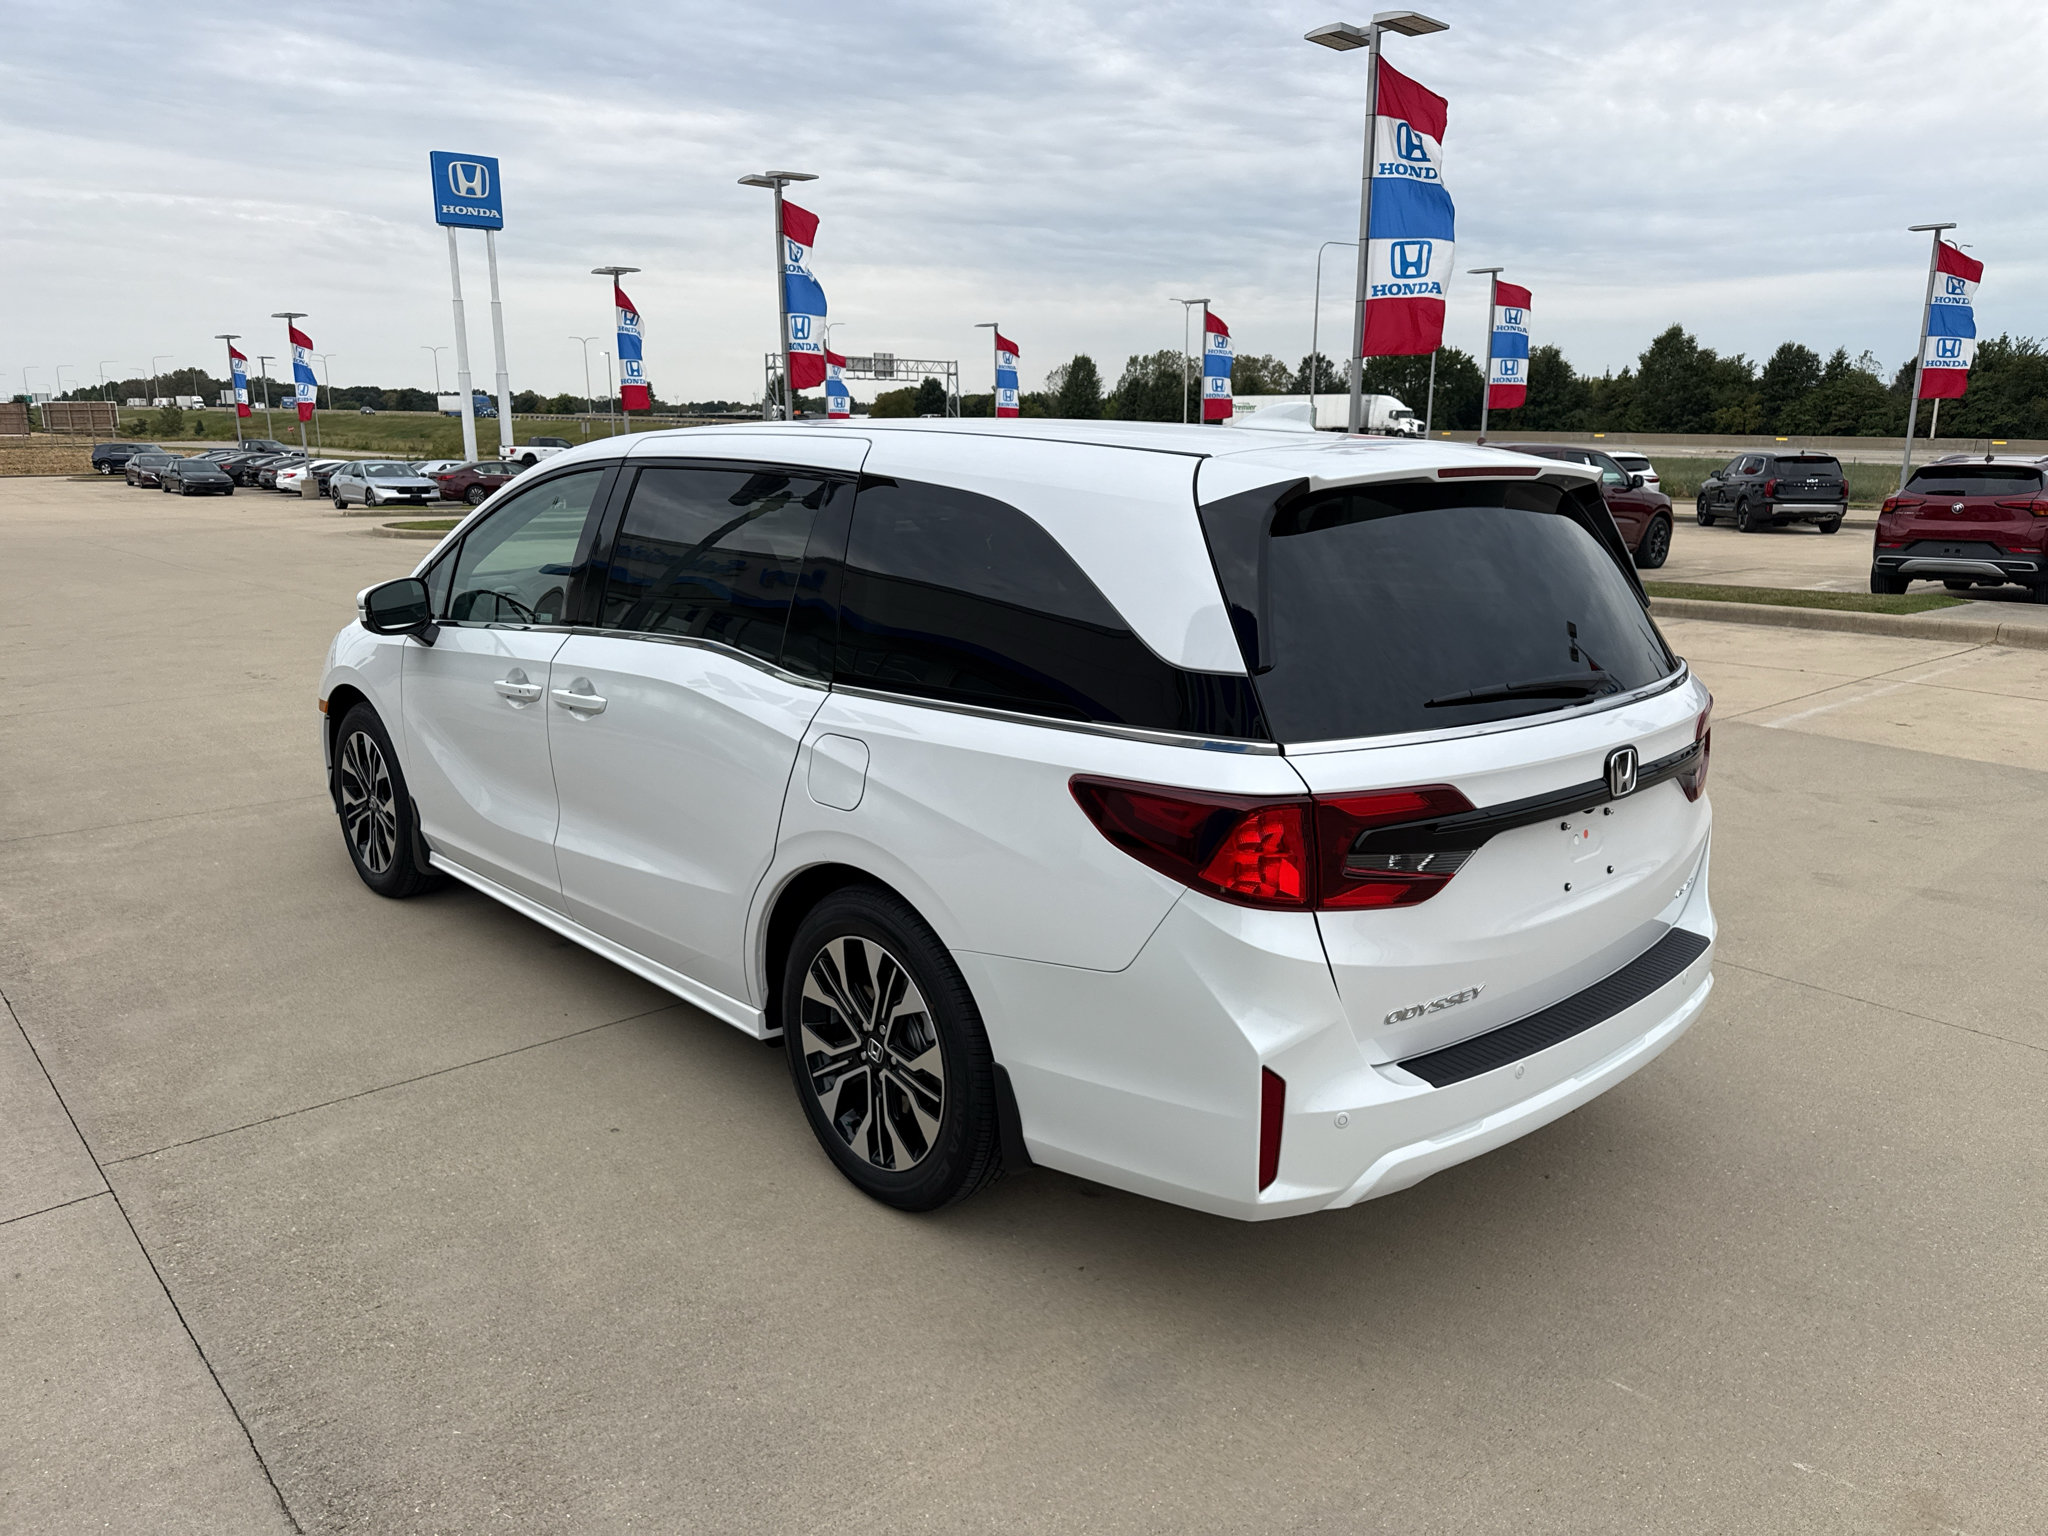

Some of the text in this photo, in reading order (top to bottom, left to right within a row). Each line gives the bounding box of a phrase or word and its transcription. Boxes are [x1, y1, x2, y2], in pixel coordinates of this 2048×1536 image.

[1379, 163, 1438, 179] HOND
[441, 204, 501, 219] HONDA
[1371, 282, 1442, 297] HONDA
[1934, 296, 1970, 304] HOND
[1496, 325, 1528, 333] HONDA
[1383, 982, 1487, 1026] ODYSSEY
